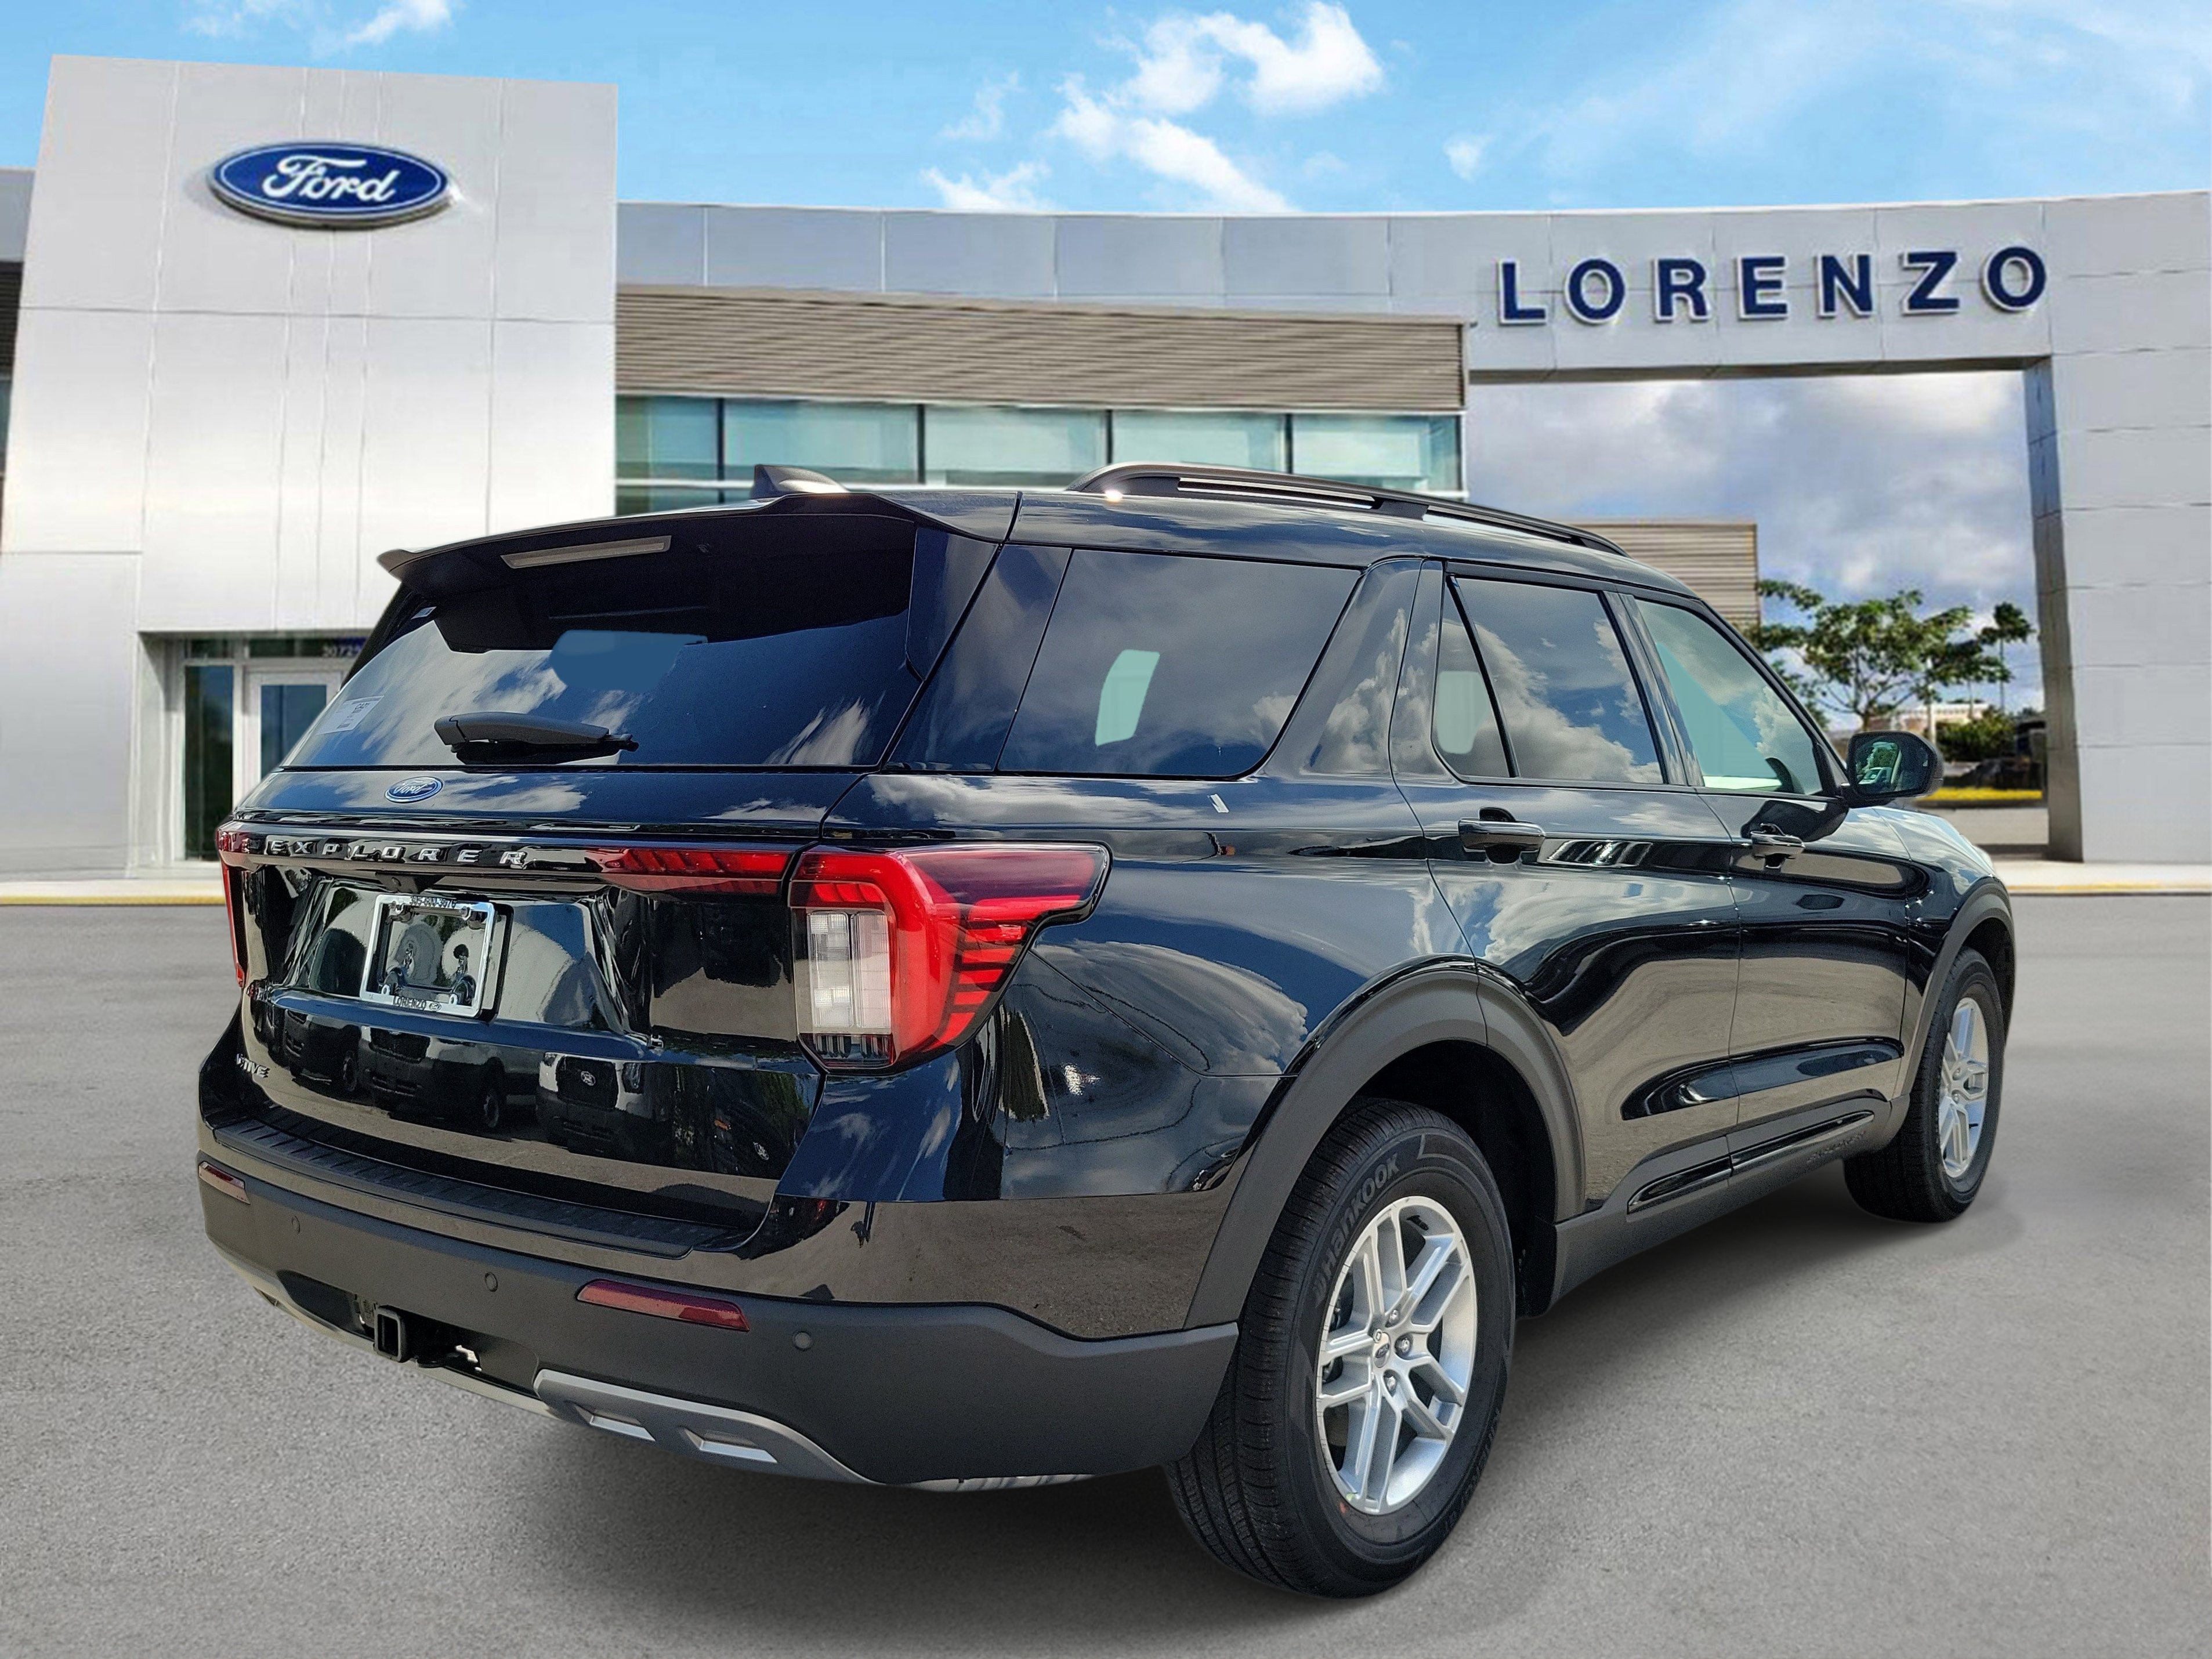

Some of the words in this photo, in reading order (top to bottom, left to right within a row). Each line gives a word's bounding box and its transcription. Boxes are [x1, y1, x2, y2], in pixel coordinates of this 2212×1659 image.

[262, 154, 401, 202] Ford
[1500, 246, 2047, 324] LORENZO
[393, 780, 428, 794] Ford
[271, 840, 524, 864] EXPLORER
[393, 995, 427, 1010] LORENZO
